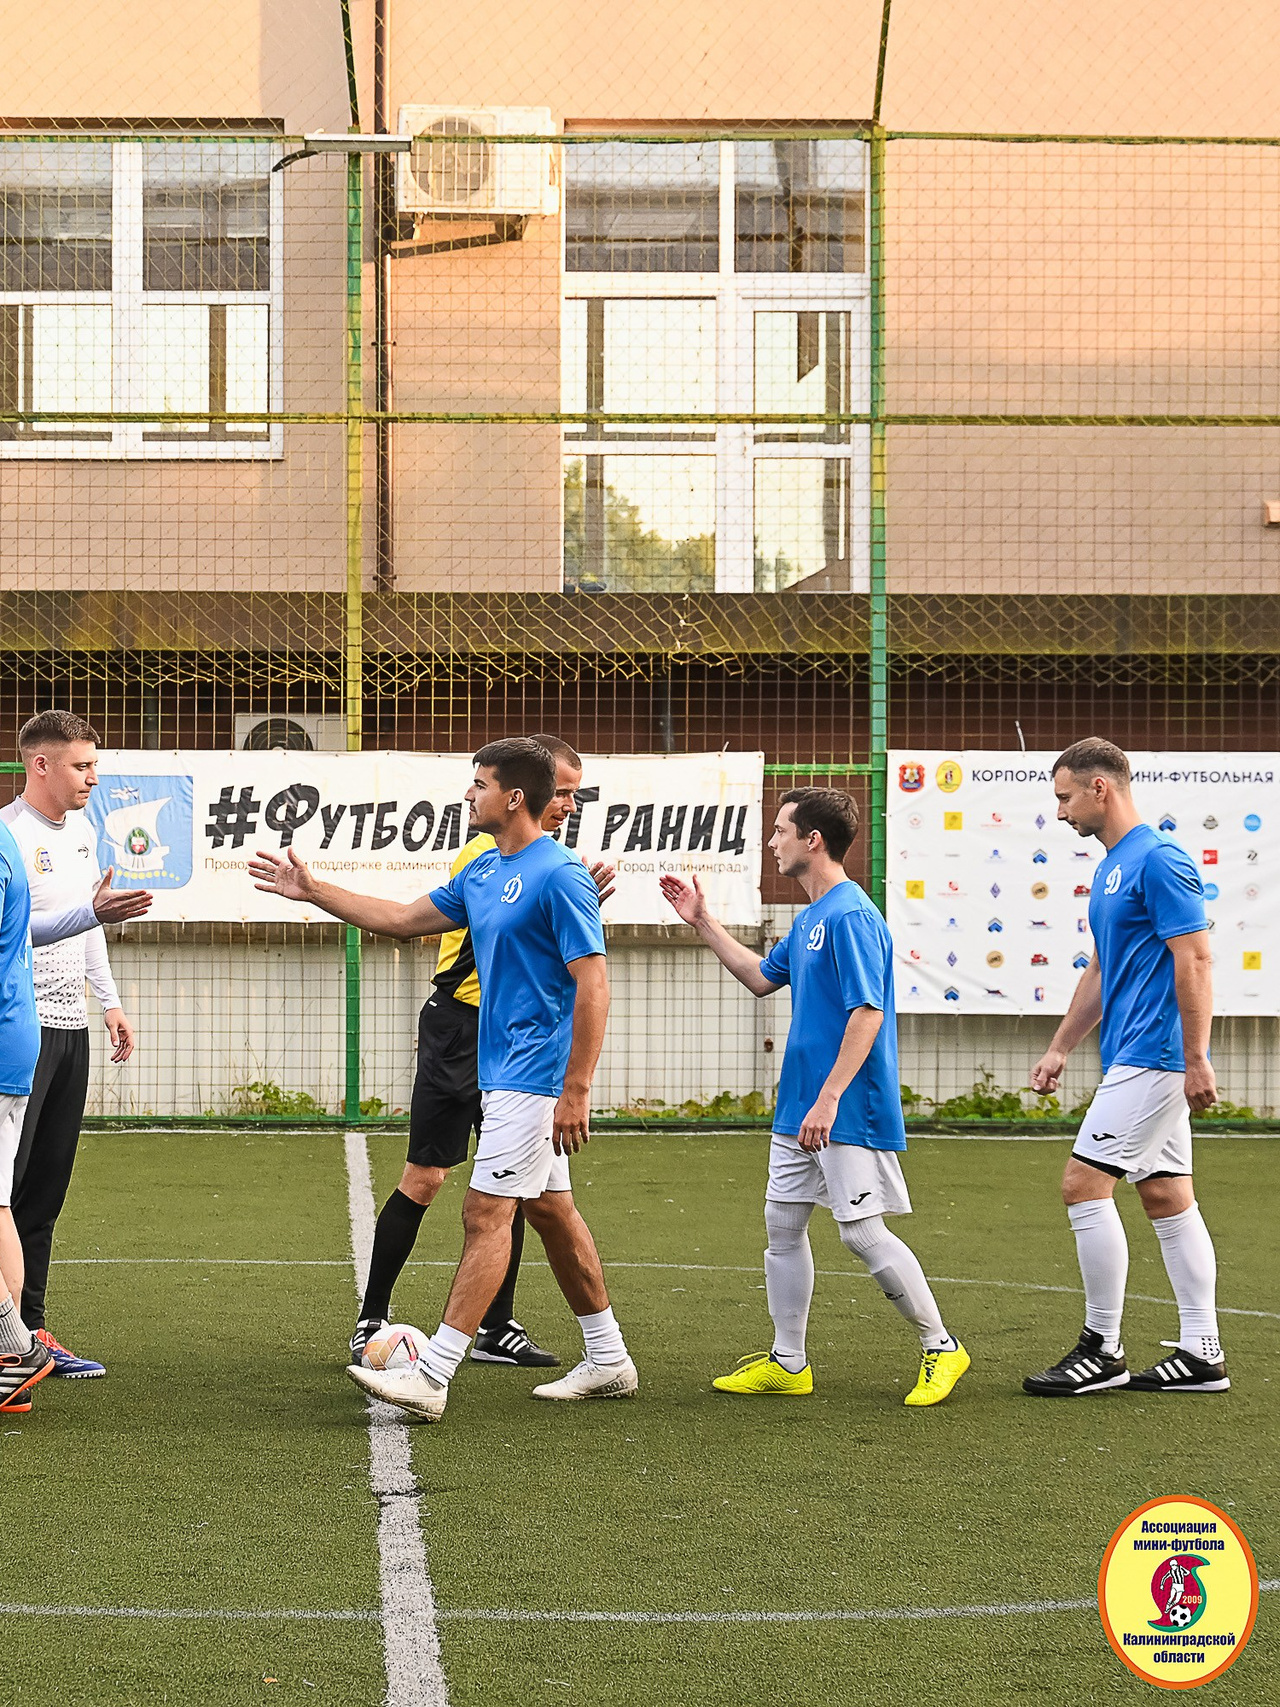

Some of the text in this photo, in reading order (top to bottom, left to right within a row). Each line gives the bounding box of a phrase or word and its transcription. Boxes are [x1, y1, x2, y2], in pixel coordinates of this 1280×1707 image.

[972, 769, 1273, 783] КОРПОРАТ ИНИ-ФУТБОЛЬНАЯ
[205, 858, 249, 871] Прово
[312, 860, 382, 872] поддержке
[386, 860, 452, 873] администр
[659, 861, 748, 874] Калининград»
